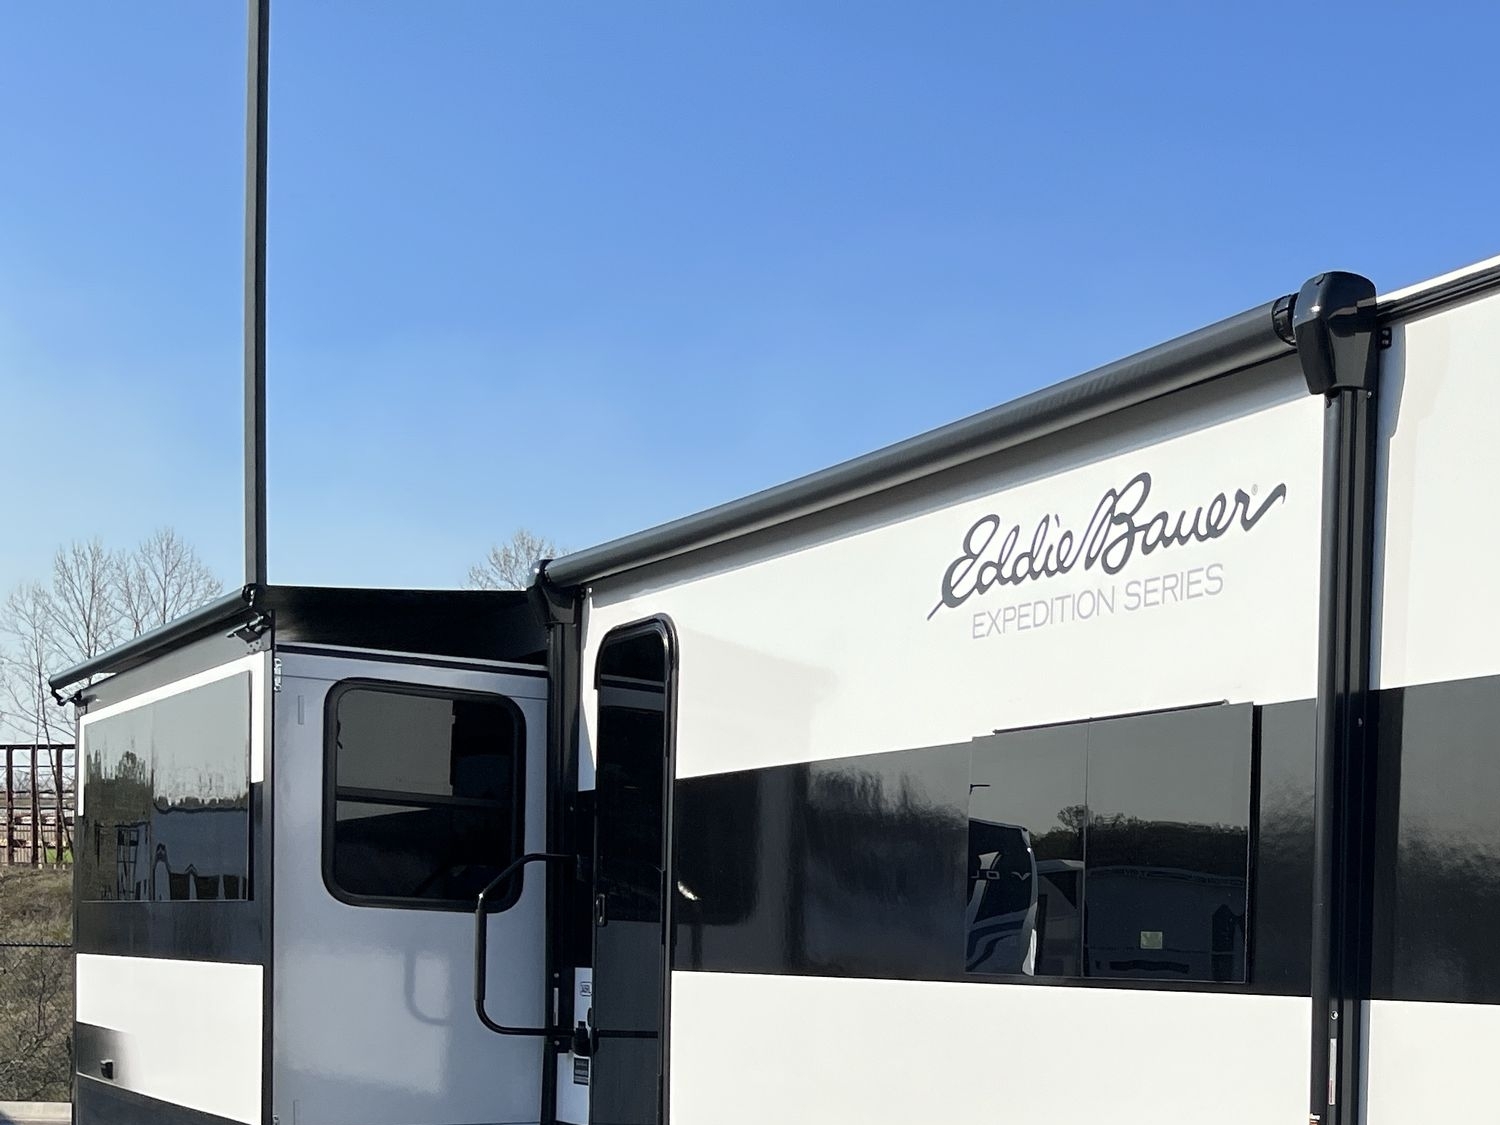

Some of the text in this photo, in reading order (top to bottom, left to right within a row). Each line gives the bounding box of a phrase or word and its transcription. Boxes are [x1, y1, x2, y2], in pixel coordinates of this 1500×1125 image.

[927, 471, 1287, 621] Eddie Bauer
[972, 562, 1224, 640] EXPEDITION SERIES
